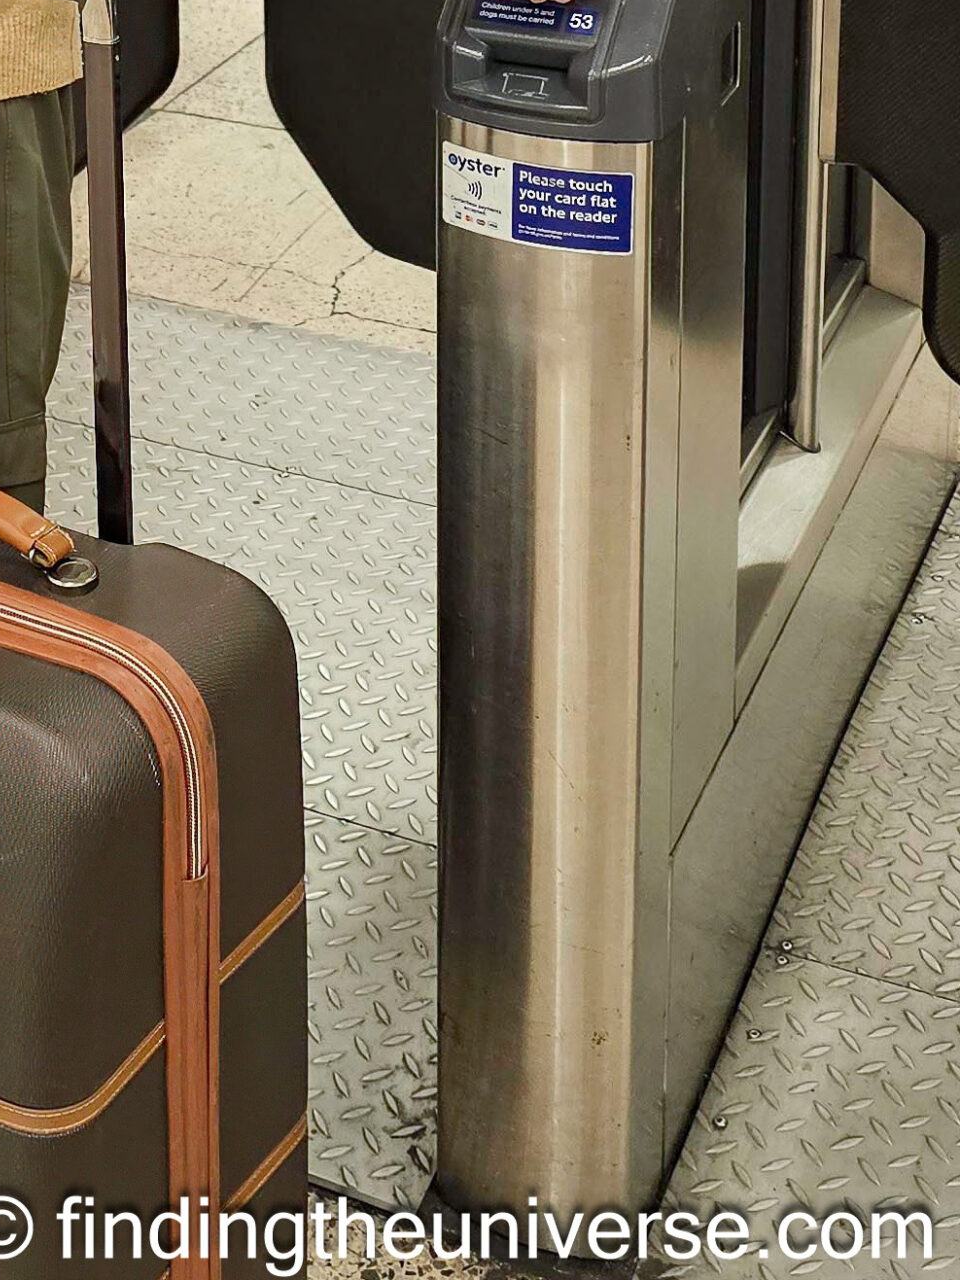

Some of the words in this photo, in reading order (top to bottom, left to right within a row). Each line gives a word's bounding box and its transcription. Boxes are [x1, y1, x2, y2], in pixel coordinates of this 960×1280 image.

[479, 9, 498, 19] dogs
[498, 12, 517, 20] must
[517, 14, 528, 22] be
[528, 16, 555, 25] carried
[481, 1, 511, 12] Children
[512, 5, 533, 14] under
[540, 9, 556, 17] and
[569, 13, 594, 30] 53
[448, 152, 502, 178] oyster
[519, 170, 565, 188] Please
[569, 178, 613, 193] touch
[519, 187, 551, 202] your
[554, 193, 587, 206] card
[590, 194, 617, 208] flat
[519, 203, 537, 215] on
[541, 205, 566, 219] the
[569, 210, 617, 224] reader
